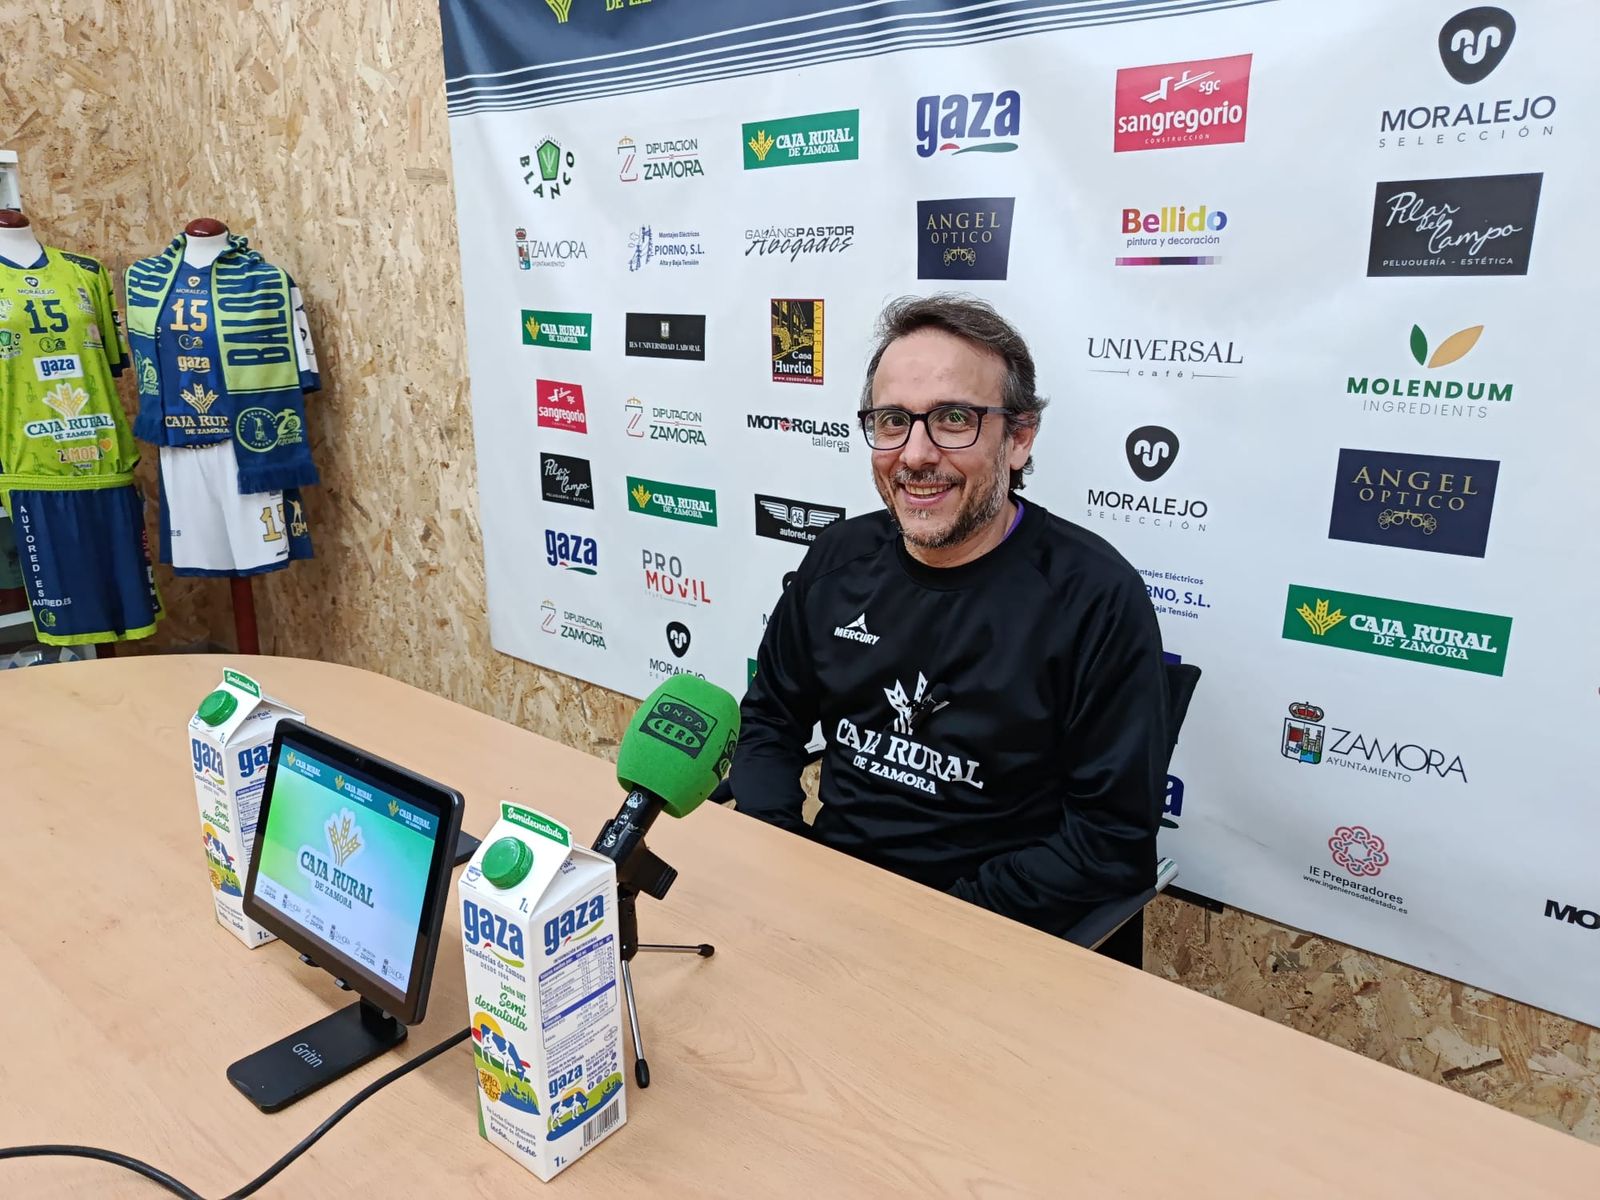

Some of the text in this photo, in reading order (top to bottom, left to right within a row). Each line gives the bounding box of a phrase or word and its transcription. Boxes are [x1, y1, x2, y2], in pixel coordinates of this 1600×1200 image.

[1199, 78, 1221, 95] sgc
[916, 90, 1020, 158] gaza
[1117, 100, 1243, 136] sangregorio
[1380, 95, 1557, 132] MORALEJO
[776, 127, 854, 150] CAJA RURAL
[1144, 133, 1211, 144] CONSTRUCCIÓN
[1379, 126, 1554, 148] SELECCIÓN
[788, 143, 840, 158] DE ZAMORA
[643, 159, 704, 181] ZAMORA
[926, 211, 1001, 231] ANGEL
[1121, 205, 1228, 234] Bellido
[1416, 213, 1445, 232] del
[745, 236, 853, 262] Abogados
[931, 230, 993, 245] OPTICO
[1126, 235, 1220, 248] pintura y decoración
[1428, 219, 1523, 255] Campo
[530, 240, 587, 259] ZAMORA
[654, 244, 705, 256] PIORNO, S.L.
[1383, 257, 1447, 267] PELUQUERÍA
[1460, 256, 1514, 266] ESTÉTICA
[24, 299, 69, 334] 15
[170, 298, 208, 332] 15
[540, 323, 588, 337] CAJA RURAL
[639, 341, 675, 350] UNIVERSIDAD
[676, 344, 702, 352] LABORAL
[791, 351, 812, 360] Casa
[1087, 337, 1244, 364] UNIVERSAL
[41, 359, 75, 376] gaza
[177, 355, 211, 372] gaza
[774, 360, 812, 374] Aurelia
[1138, 369, 1184, 378] café
[1346, 376, 1514, 402] MOLENDUM
[165, 415, 197, 427] CAJA
[538, 406, 585, 424] sangregorio
[1362, 399, 1488, 419] INGREDIENTS
[27, 420, 62, 436] CAJA
[649, 425, 707, 446] ZAMORA
[747, 414, 850, 438] MOTORGLASS
[812, 436, 850, 448] talleres
[1352, 465, 1478, 495] ANGEL
[652, 493, 713, 513] CAJA RURAL
[1088, 489, 1208, 518] MORALEJO
[1359, 487, 1465, 511] OPTICO
[663, 505, 703, 518] DE ZAMORA
[1087, 509, 1207, 532] SELECCIÓN
[545, 529, 598, 566] gaza
[642, 549, 682, 578] PRO
[1164, 572, 1204, 585] Eléctricos
[1145, 584, 1211, 608] RNO, S.L.
[1168, 607, 1199, 619] Tensión
[561, 625, 606, 650] ZAMORA
[834, 627, 880, 645] MERCURY
[1349, 614, 1497, 654] CAJA RURAL
[1373, 633, 1469, 660] DE ZAMORA
[662, 704, 704, 730] ONDA
[654, 719, 696, 746] CERO
[192, 738, 224, 778] gaza
[238, 743, 271, 778] ga
[836, 718, 984, 790] CAJA RURAL
[1329, 727, 1468, 784] ZAMORA
[853, 755, 936, 795] DE ZAMORA
[1326, 756, 1412, 783] AYUNTAMIENTO
[300, 851, 374, 908] CAJA RURAL
[1309, 865, 1404, 905] IE Preparadores
[314, 880, 352, 909] DE ZAMORA
[1303, 875, 1408, 914] www.ingenierosdelestado.es
[463, 899, 524, 960] gaza
[544, 895, 605, 956] gaza
[475, 995, 528, 1031] desnatada
[499, 992, 527, 1017] Semi
[549, 1064, 583, 1098] gaza
